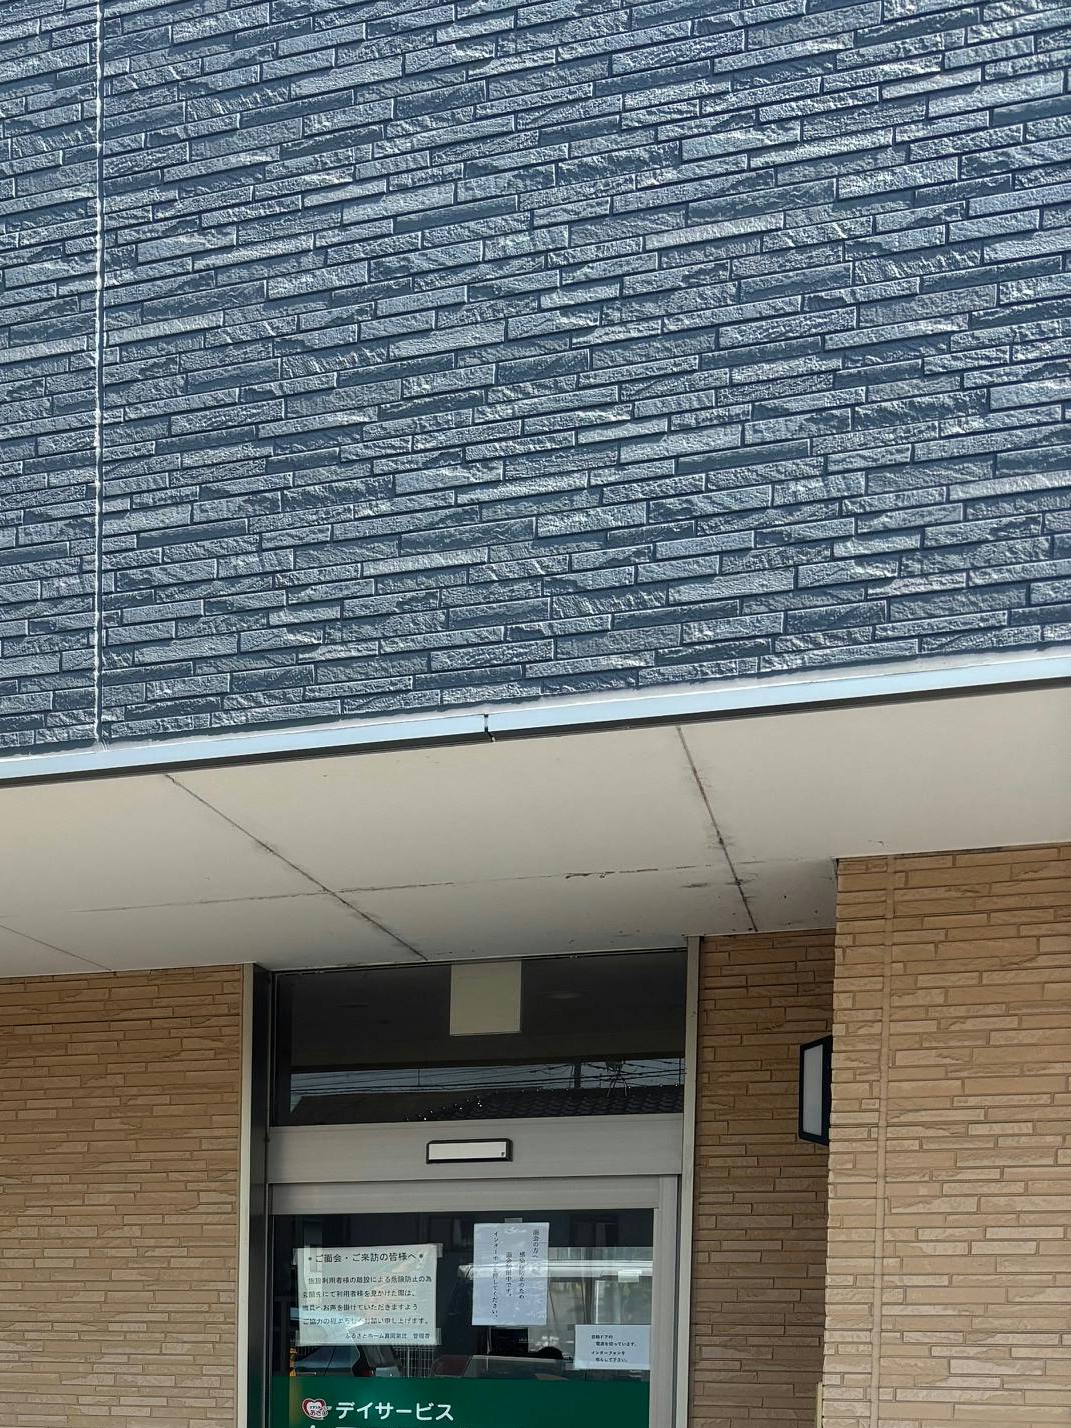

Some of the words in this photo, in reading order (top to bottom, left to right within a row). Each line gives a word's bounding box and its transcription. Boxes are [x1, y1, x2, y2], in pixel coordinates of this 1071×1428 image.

[335, 1401, 454, 1421] デイサービス
